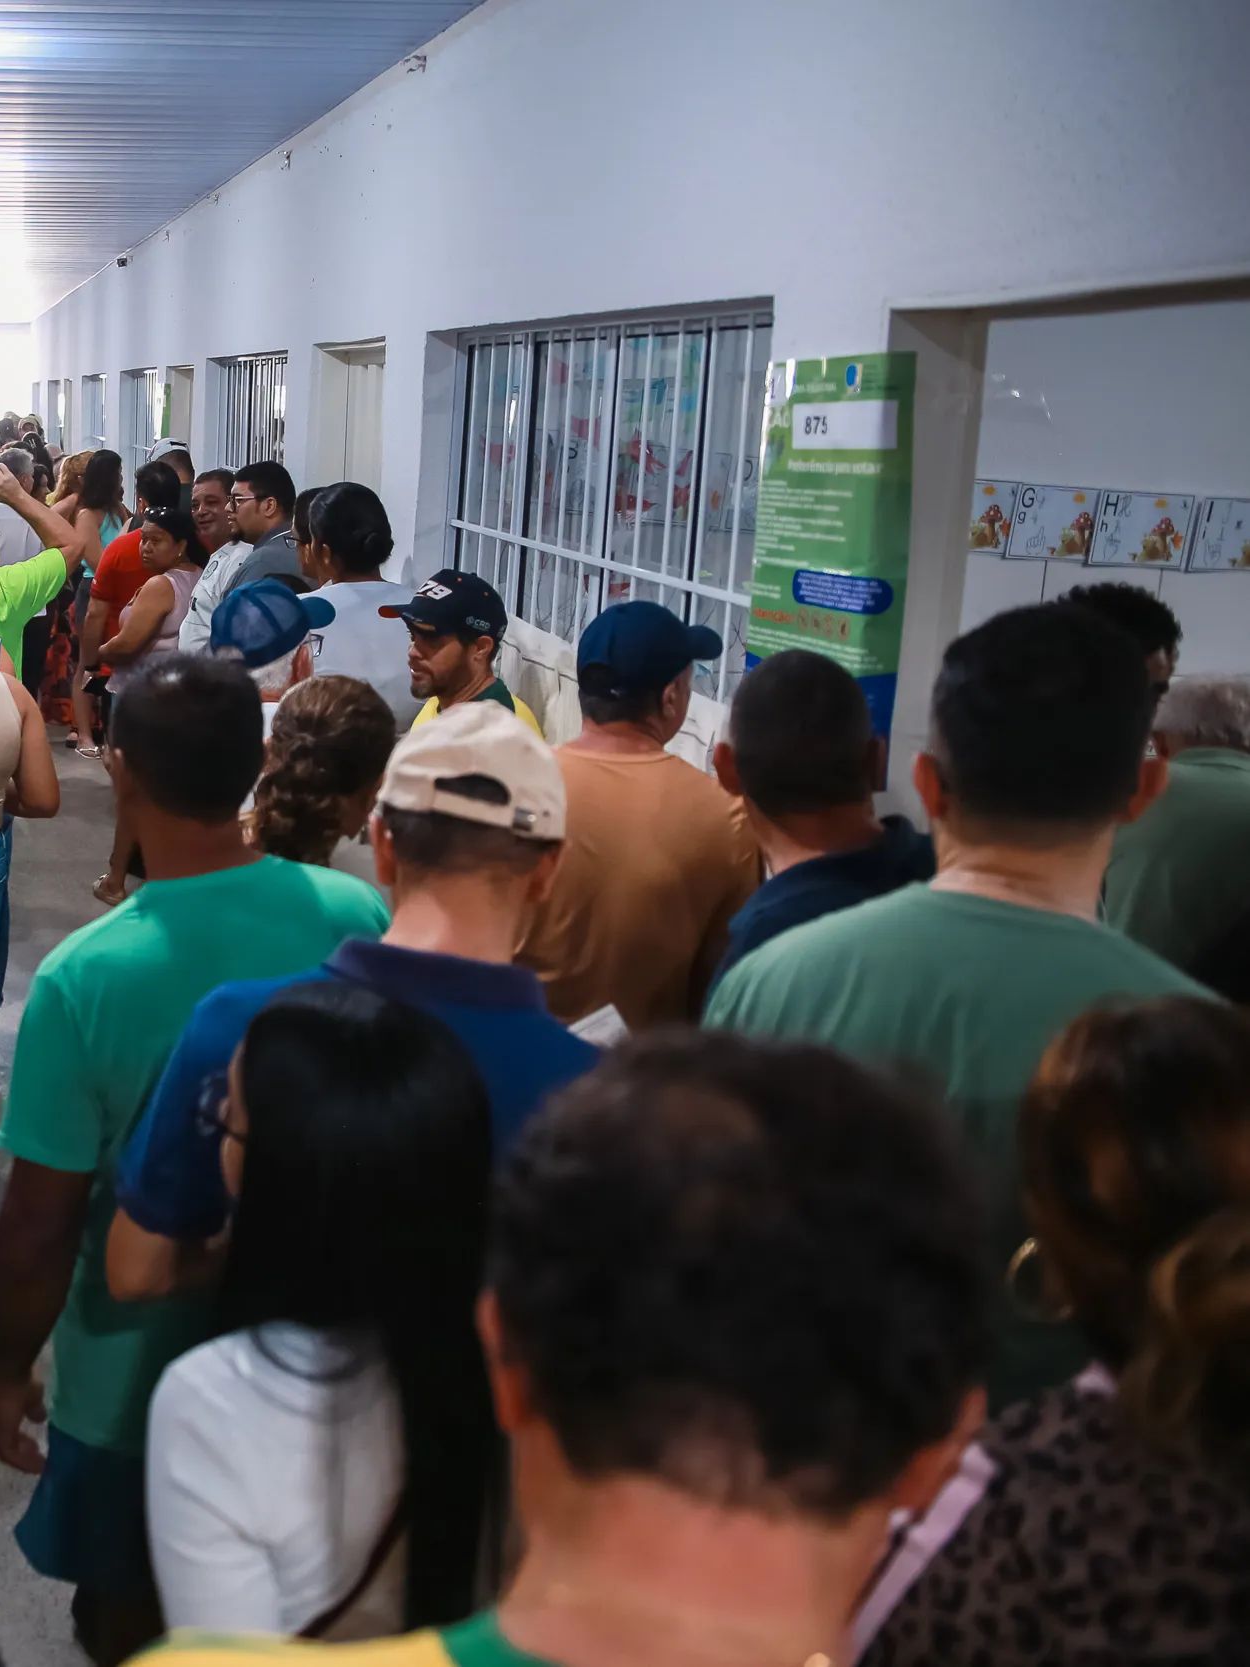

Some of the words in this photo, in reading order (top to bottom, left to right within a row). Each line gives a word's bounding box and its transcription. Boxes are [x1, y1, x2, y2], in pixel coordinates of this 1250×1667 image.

[804, 415, 829, 435] 875
[1021, 487, 1036, 508] G
[1103, 494, 1120, 517] H
[1017, 511, 1027, 524] g
[1100, 519, 1108, 532] h
[416, 579, 453, 600] 79
